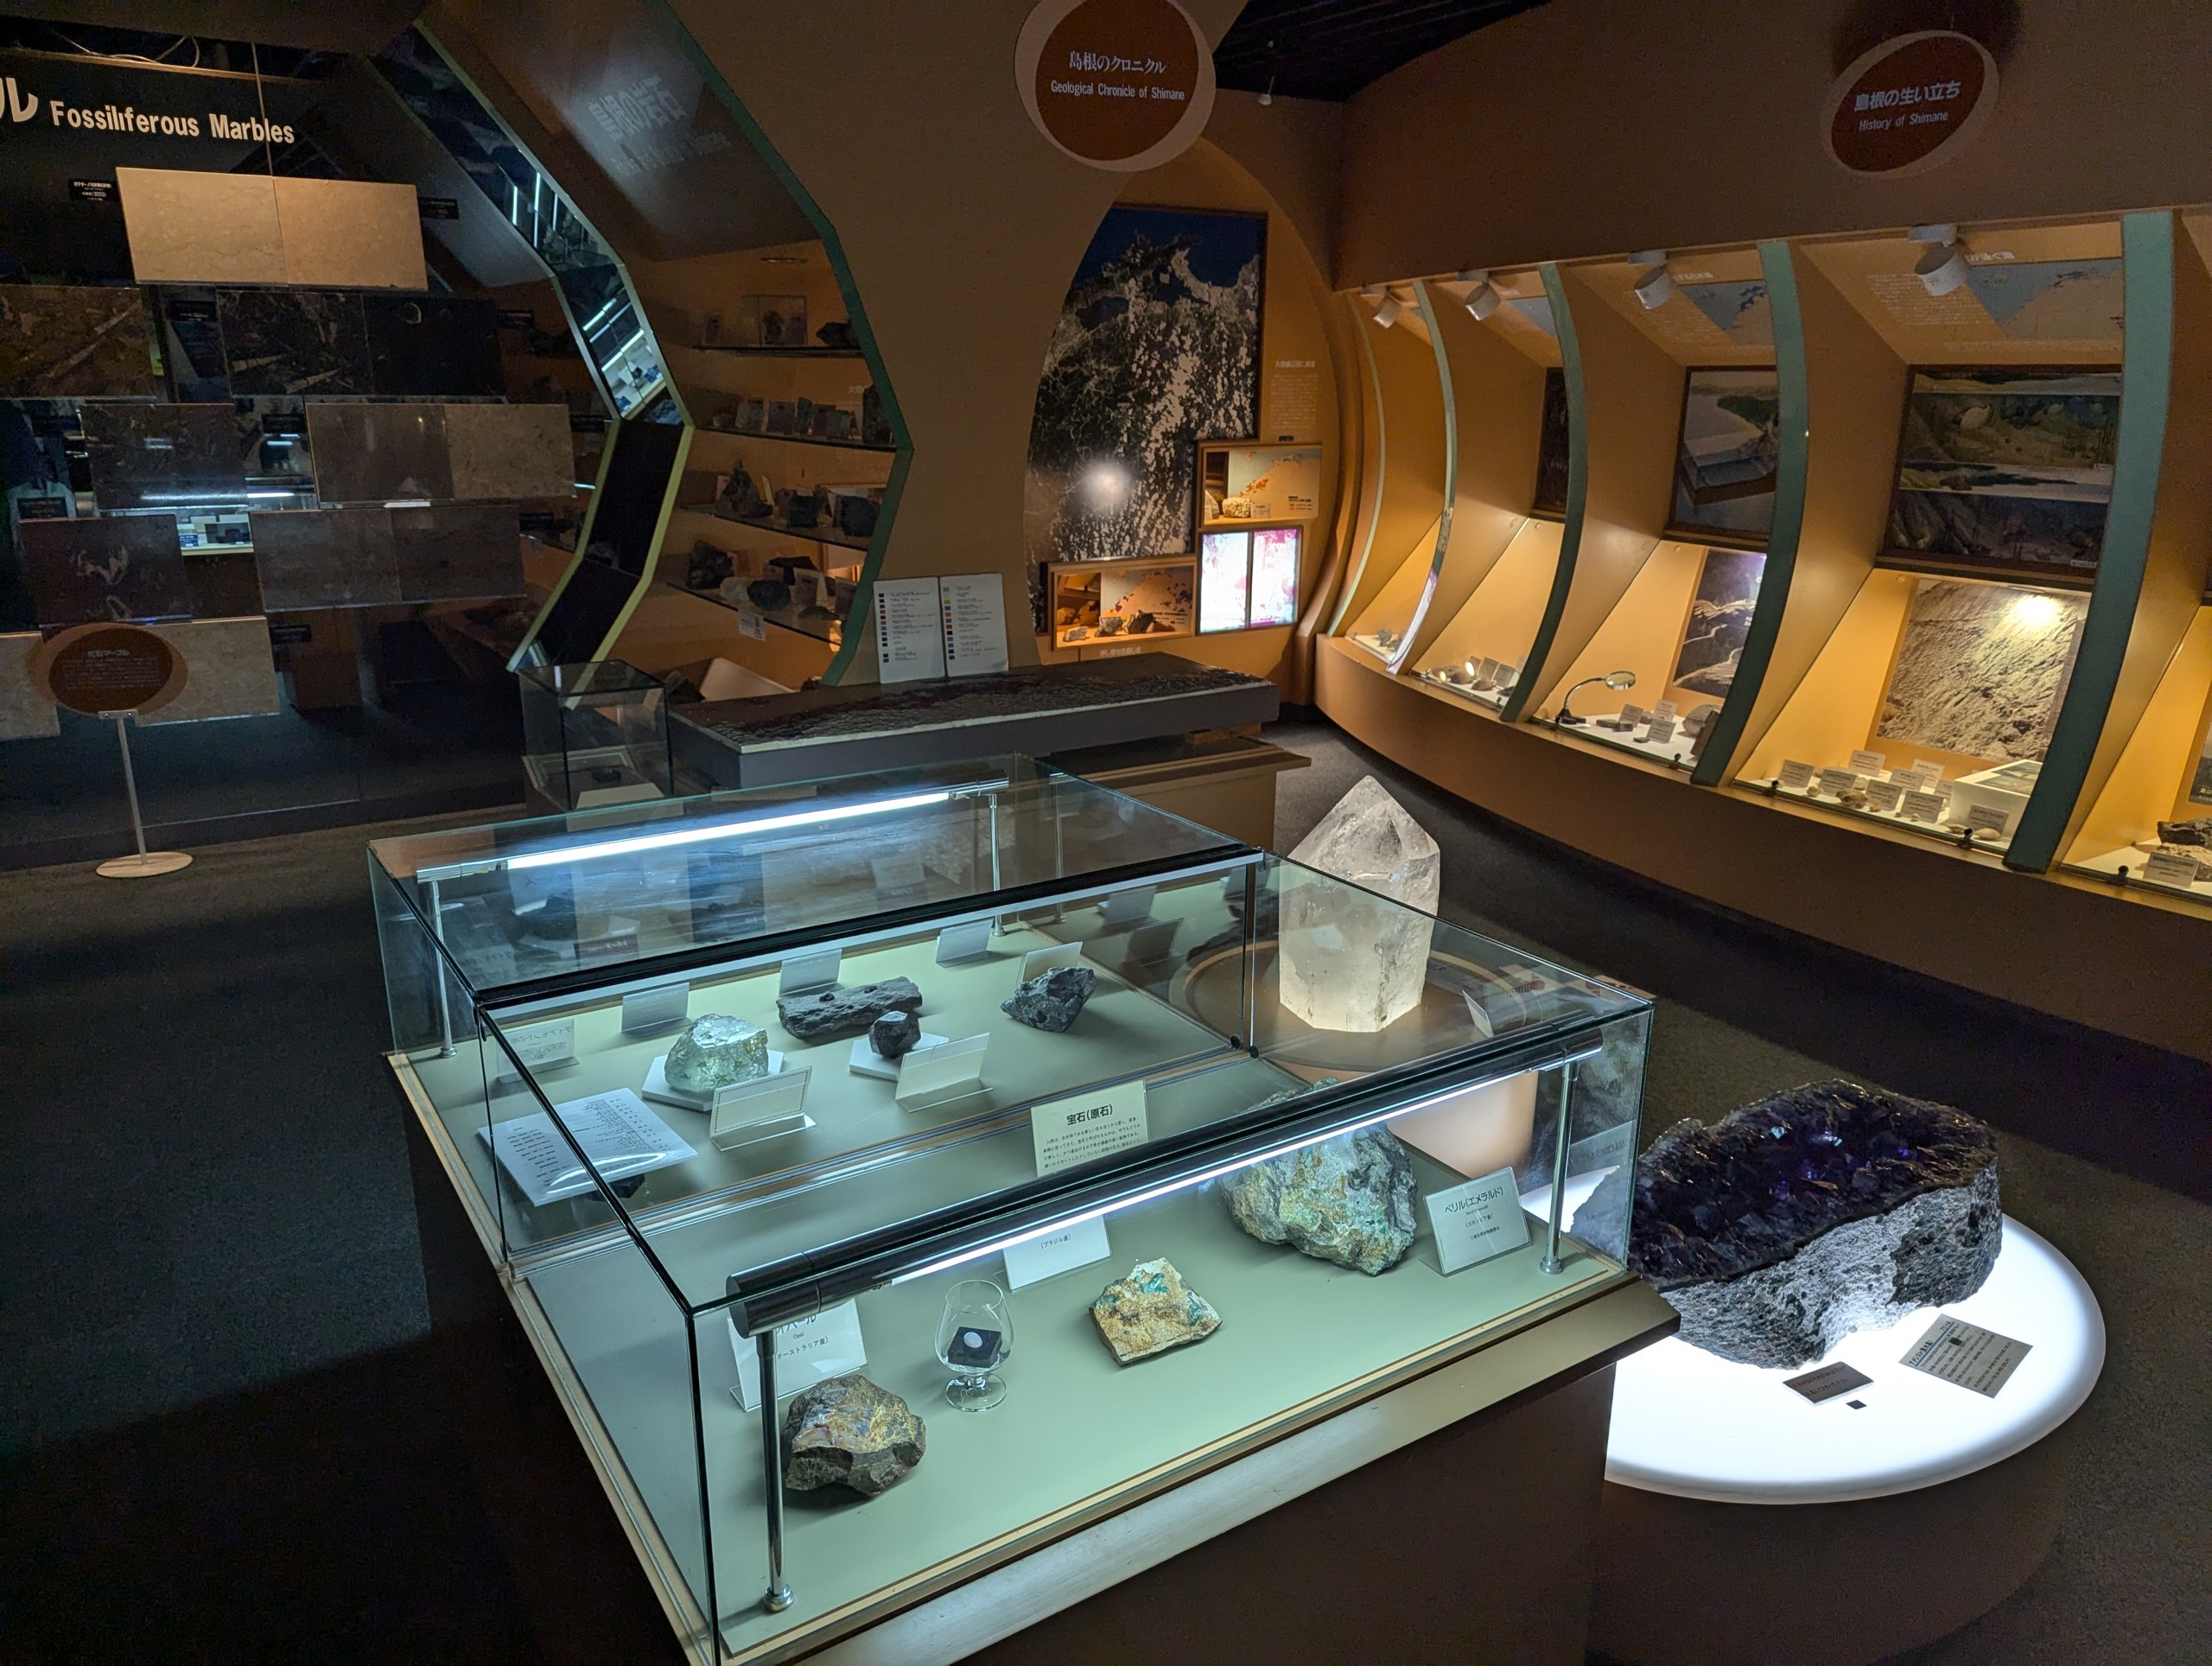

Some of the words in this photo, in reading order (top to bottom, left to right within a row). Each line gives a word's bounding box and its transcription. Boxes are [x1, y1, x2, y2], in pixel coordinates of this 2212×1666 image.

[1069, 50, 1167, 75] 島根のクロニクル
[1051, 79, 1094, 96] Geological
[1097, 82, 1135, 98] Chronicle
[1139, 86, 1148, 99] of
[1151, 86, 1185, 100] Shimane
[1853, 79, 1961, 111] 島根の生い立ち
[48, 99, 200, 137] Fossiliferous
[208, 112, 296, 144] Marbles
[1859, 118, 1892, 131] History
[1895, 114, 1906, 126] of
[1909, 111, 1949, 125] Shimane
[1066, 1103, 1114, 1126] 宝石(原石)
[1445, 1186, 1503, 1214] ベリル(エメラルド)
[792, 1332, 804, 1341] Opal
